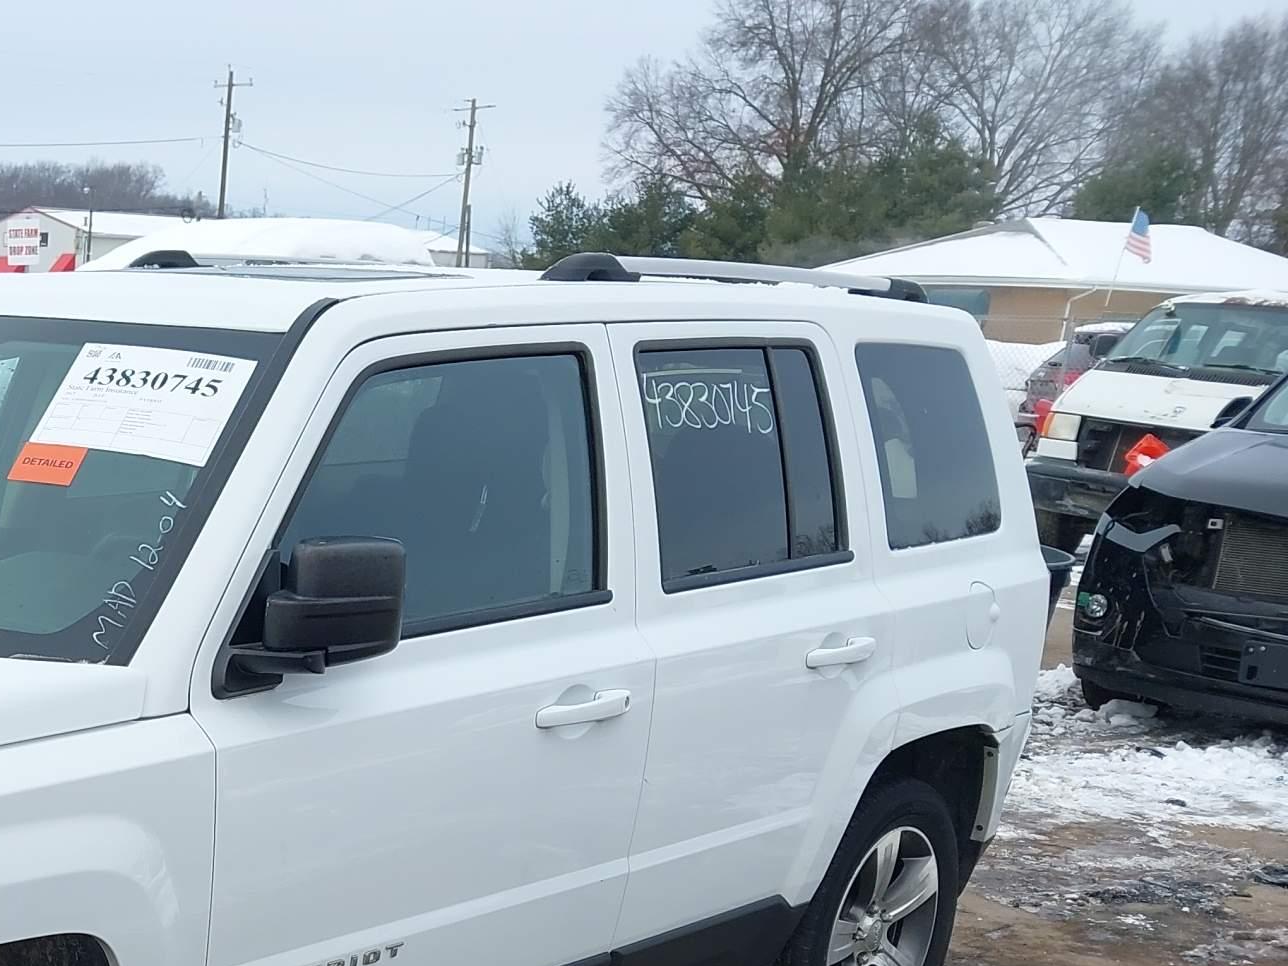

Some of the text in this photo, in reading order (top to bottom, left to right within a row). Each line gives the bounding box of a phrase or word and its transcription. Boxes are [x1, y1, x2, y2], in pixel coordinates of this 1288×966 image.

[9, 227, 39, 239] STATE FARM
[9, 245, 39, 256] DROP ZONE
[83, 366, 224, 398] 43830745
[641, 374, 774, 433] 43830745
[22, 456, 74, 469] DETAILED
